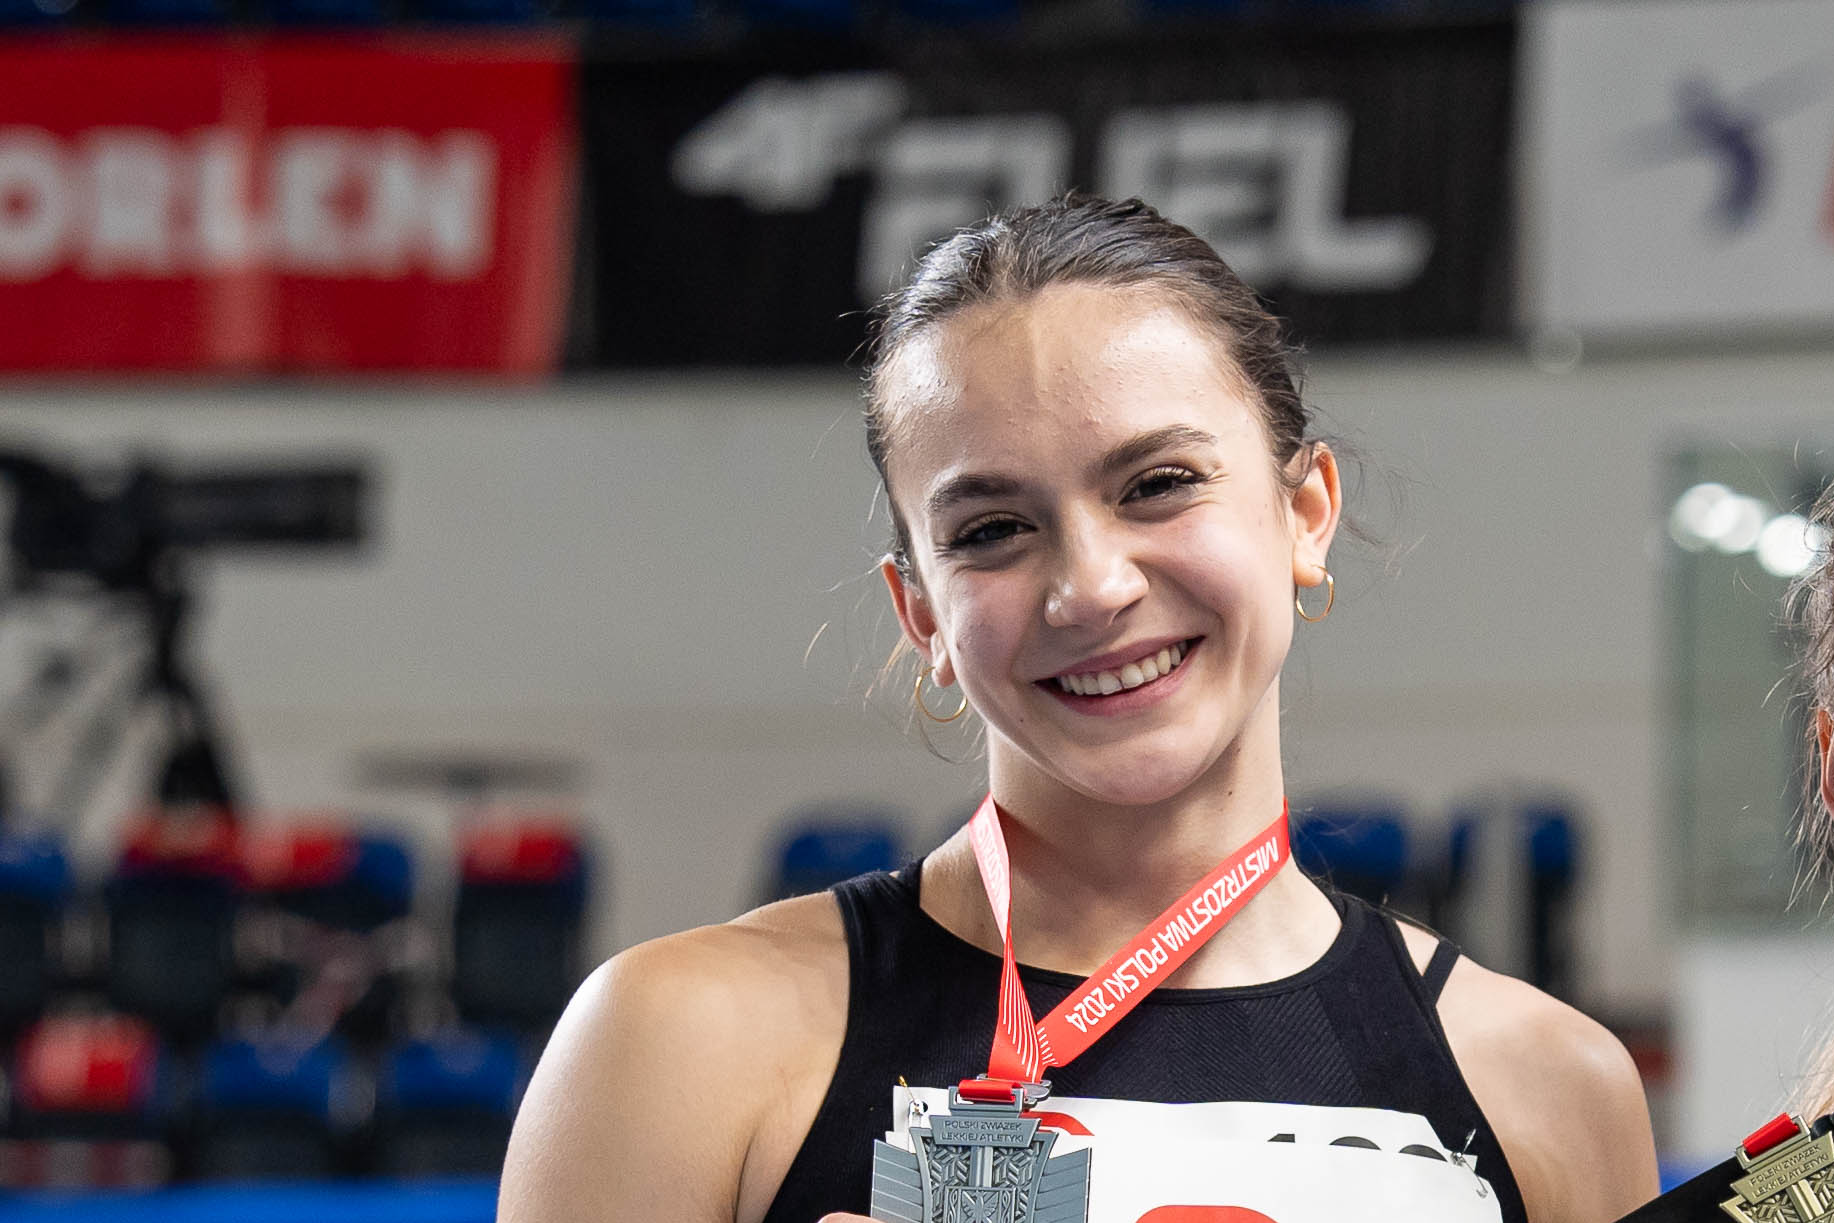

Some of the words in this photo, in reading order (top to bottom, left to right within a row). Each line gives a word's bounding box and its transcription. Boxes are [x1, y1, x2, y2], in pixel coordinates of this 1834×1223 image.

[0, 126, 500, 282] ORLEN
[1157, 836, 1280, 952] MISTRZOSTWA
[1065, 987, 1116, 1033] 2024
[1102, 937, 1169, 1002] POLSKI
